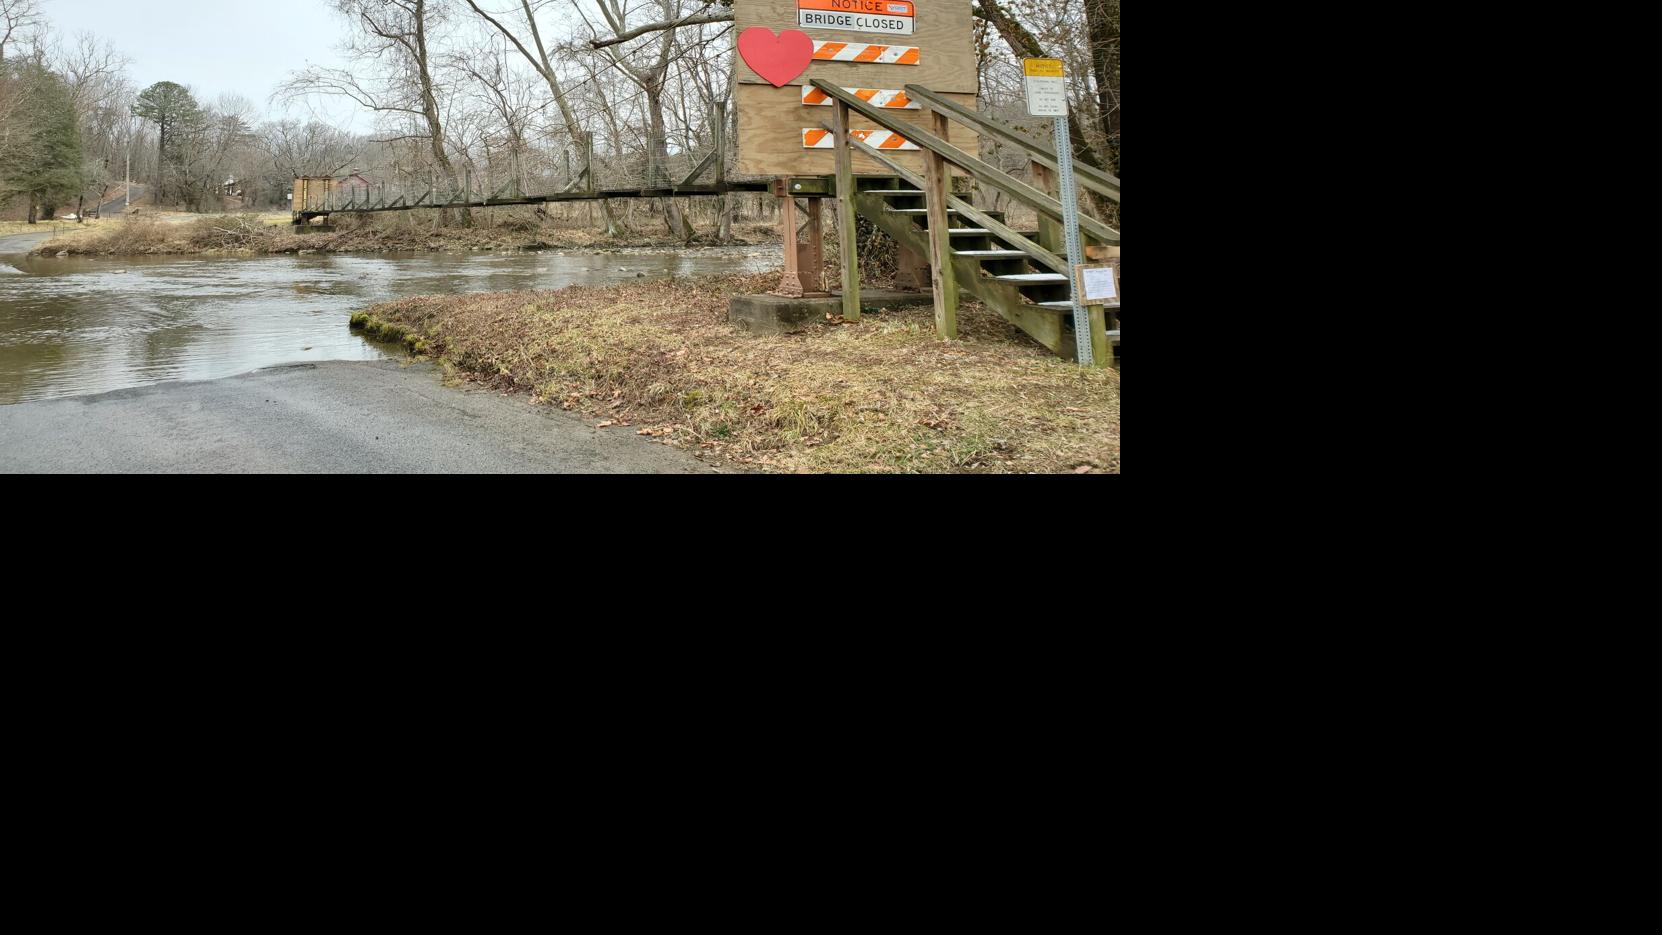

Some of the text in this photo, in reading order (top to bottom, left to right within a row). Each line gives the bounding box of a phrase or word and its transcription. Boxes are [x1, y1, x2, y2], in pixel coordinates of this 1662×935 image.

[831, 0, 883, 11] NOTICE
[805, 13, 904, 30] BRIDGE CLOSED
